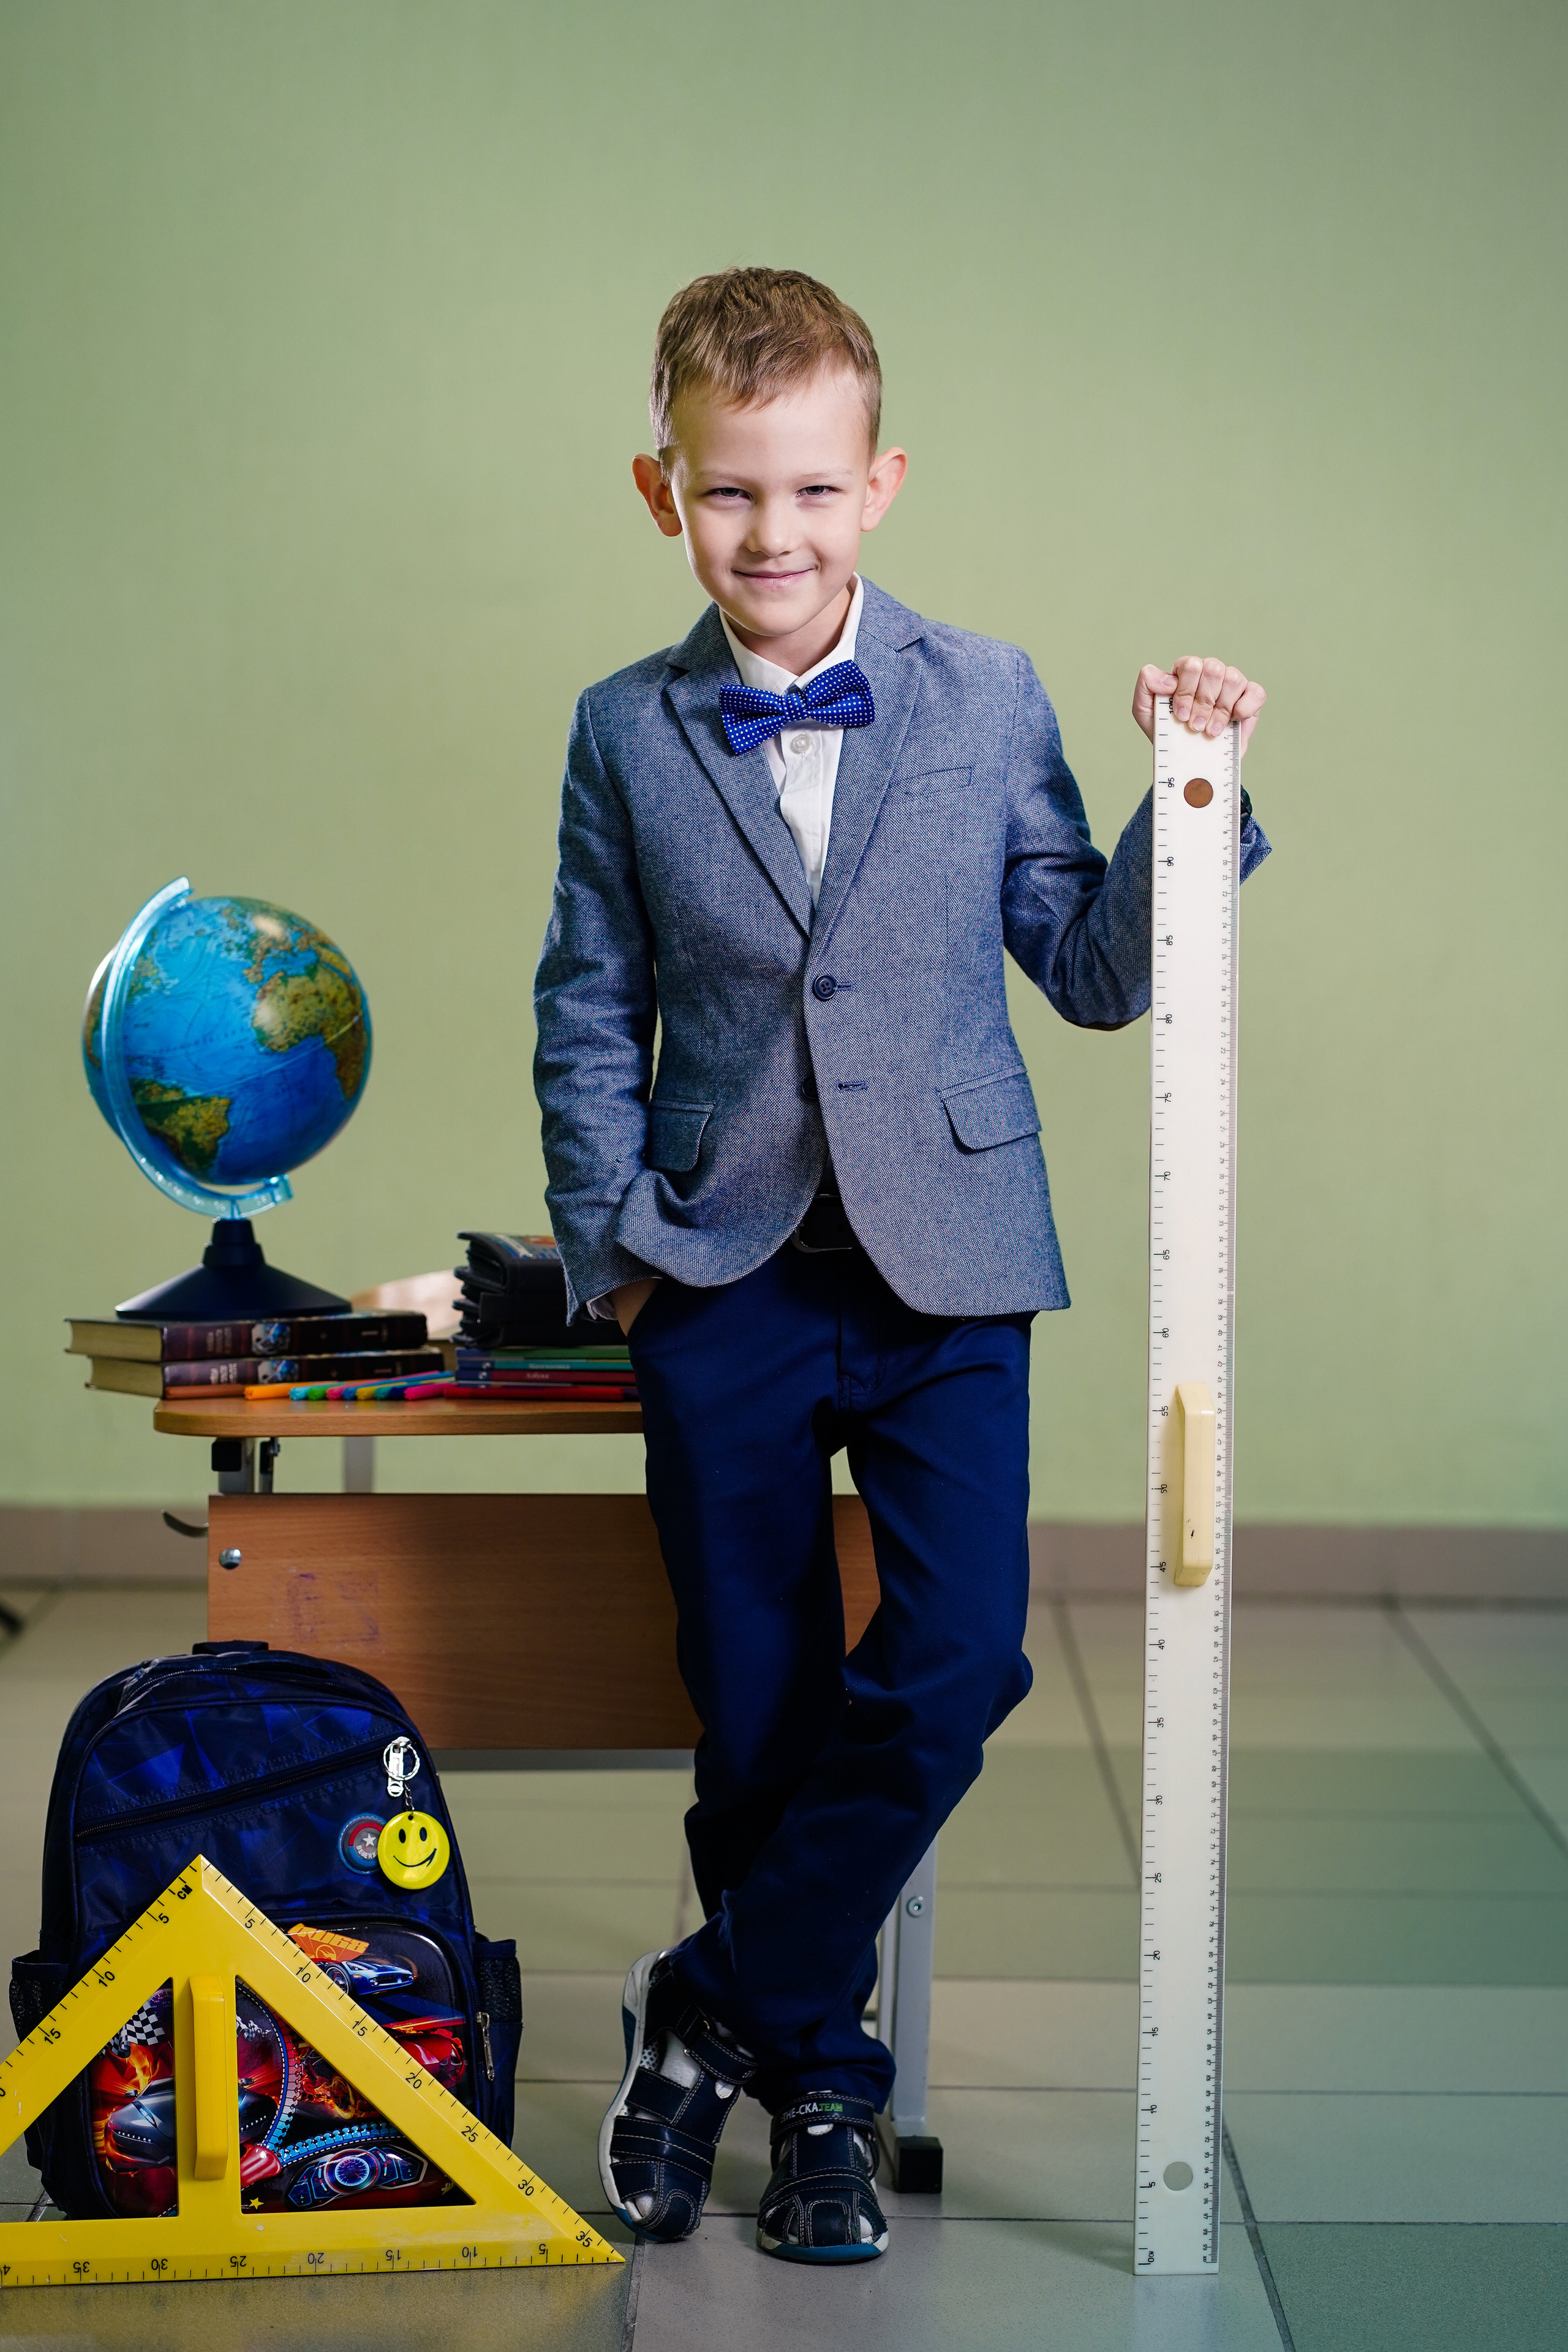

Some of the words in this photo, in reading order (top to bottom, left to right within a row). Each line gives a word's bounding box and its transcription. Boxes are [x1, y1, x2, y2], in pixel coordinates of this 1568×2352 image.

[1167, 777, 1175, 788] 95
[1167, 856, 1174, 867] 90
[1166, 935, 1174, 946] 85
[1165, 1014, 1173, 1024] 80
[1164, 1092, 1172, 1102] 75
[1164, 1171, 1171, 1180] 70
[1163, 1249, 1170, 1260] 65
[1162, 1327, 1169, 1338] 60
[1161, 1406, 1169, 1417] 55
[1160, 1483, 1168, 1494] 50
[1159, 1561, 1167, 1573] 45
[1158, 1639, 1165, 1650] 40
[1156, 1717, 1164, 1728] 35
[1155, 1795, 1163, 1805] 30
[1154, 1872, 1162, 1883] 25
[176, 1884, 193, 1900] CM
[158, 1912, 169, 1924] 5
[245, 1918, 255, 1929] 5
[1153, 1950, 1161, 1961] 20
[99, 1971, 115, 1987] 10
[295, 1967, 311, 1983] 10
[352, 2021, 368, 2037] 15
[1152, 2027, 1159, 2037] 15
[44, 2028, 61, 2045] 15
[405, 2072, 422, 2089] 20
[1150, 2105, 1158, 2114] 10
[461, 2125, 478, 2143] 25
[518, 2179, 534, 2196] 30
[576, 2231, 593, 2247] 35
[462, 2247, 478, 2258] 10
[538, 2243, 546, 2255] 5
[307, 2252, 325, 2264] 20
[385, 2249, 402, 2261] 15
[151, 2258, 168, 2270] 30
[229, 2255, 247, 2267] 25
[73, 2261, 90, 2273] 35
